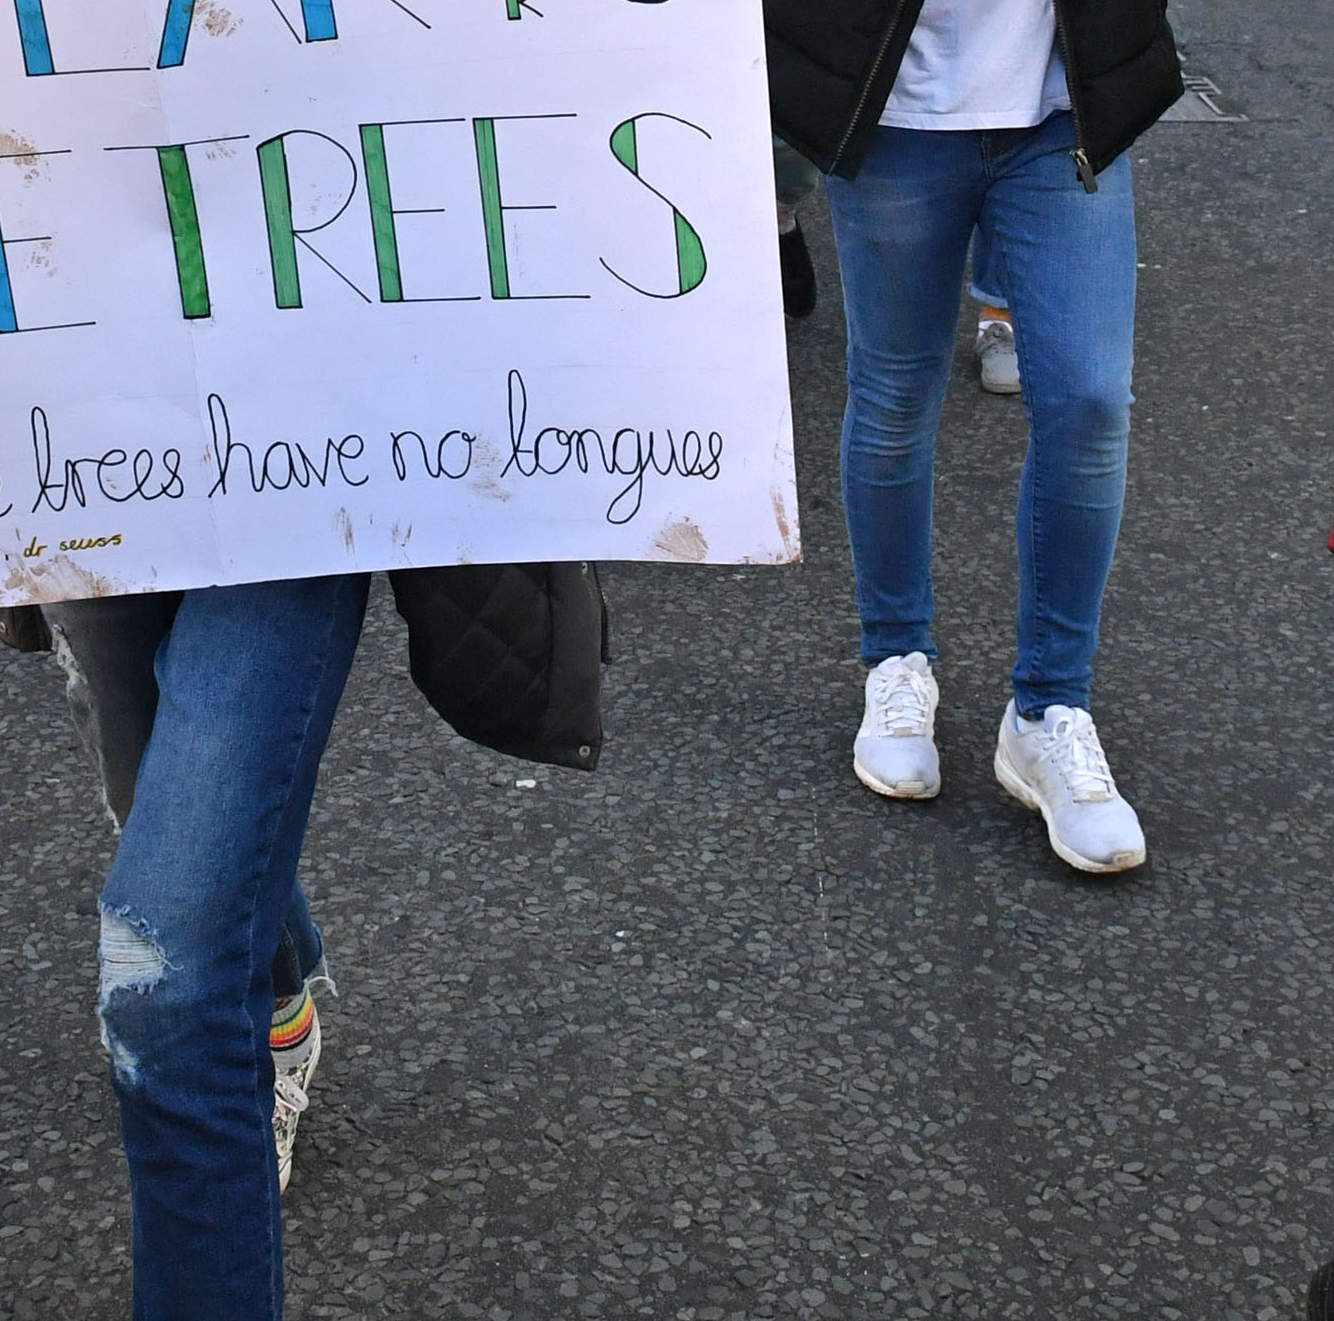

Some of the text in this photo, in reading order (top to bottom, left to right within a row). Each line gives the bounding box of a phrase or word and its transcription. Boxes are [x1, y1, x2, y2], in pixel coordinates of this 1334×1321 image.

[103, 111, 713, 320] TREES
[30, 405, 185, 514] trees
[207, 392, 370, 499] have
[389, 429, 477, 482] no
[499, 368, 725, 526] tongues
[22, 535, 50, 559] dr
[58, 533, 124, 553] seuss
